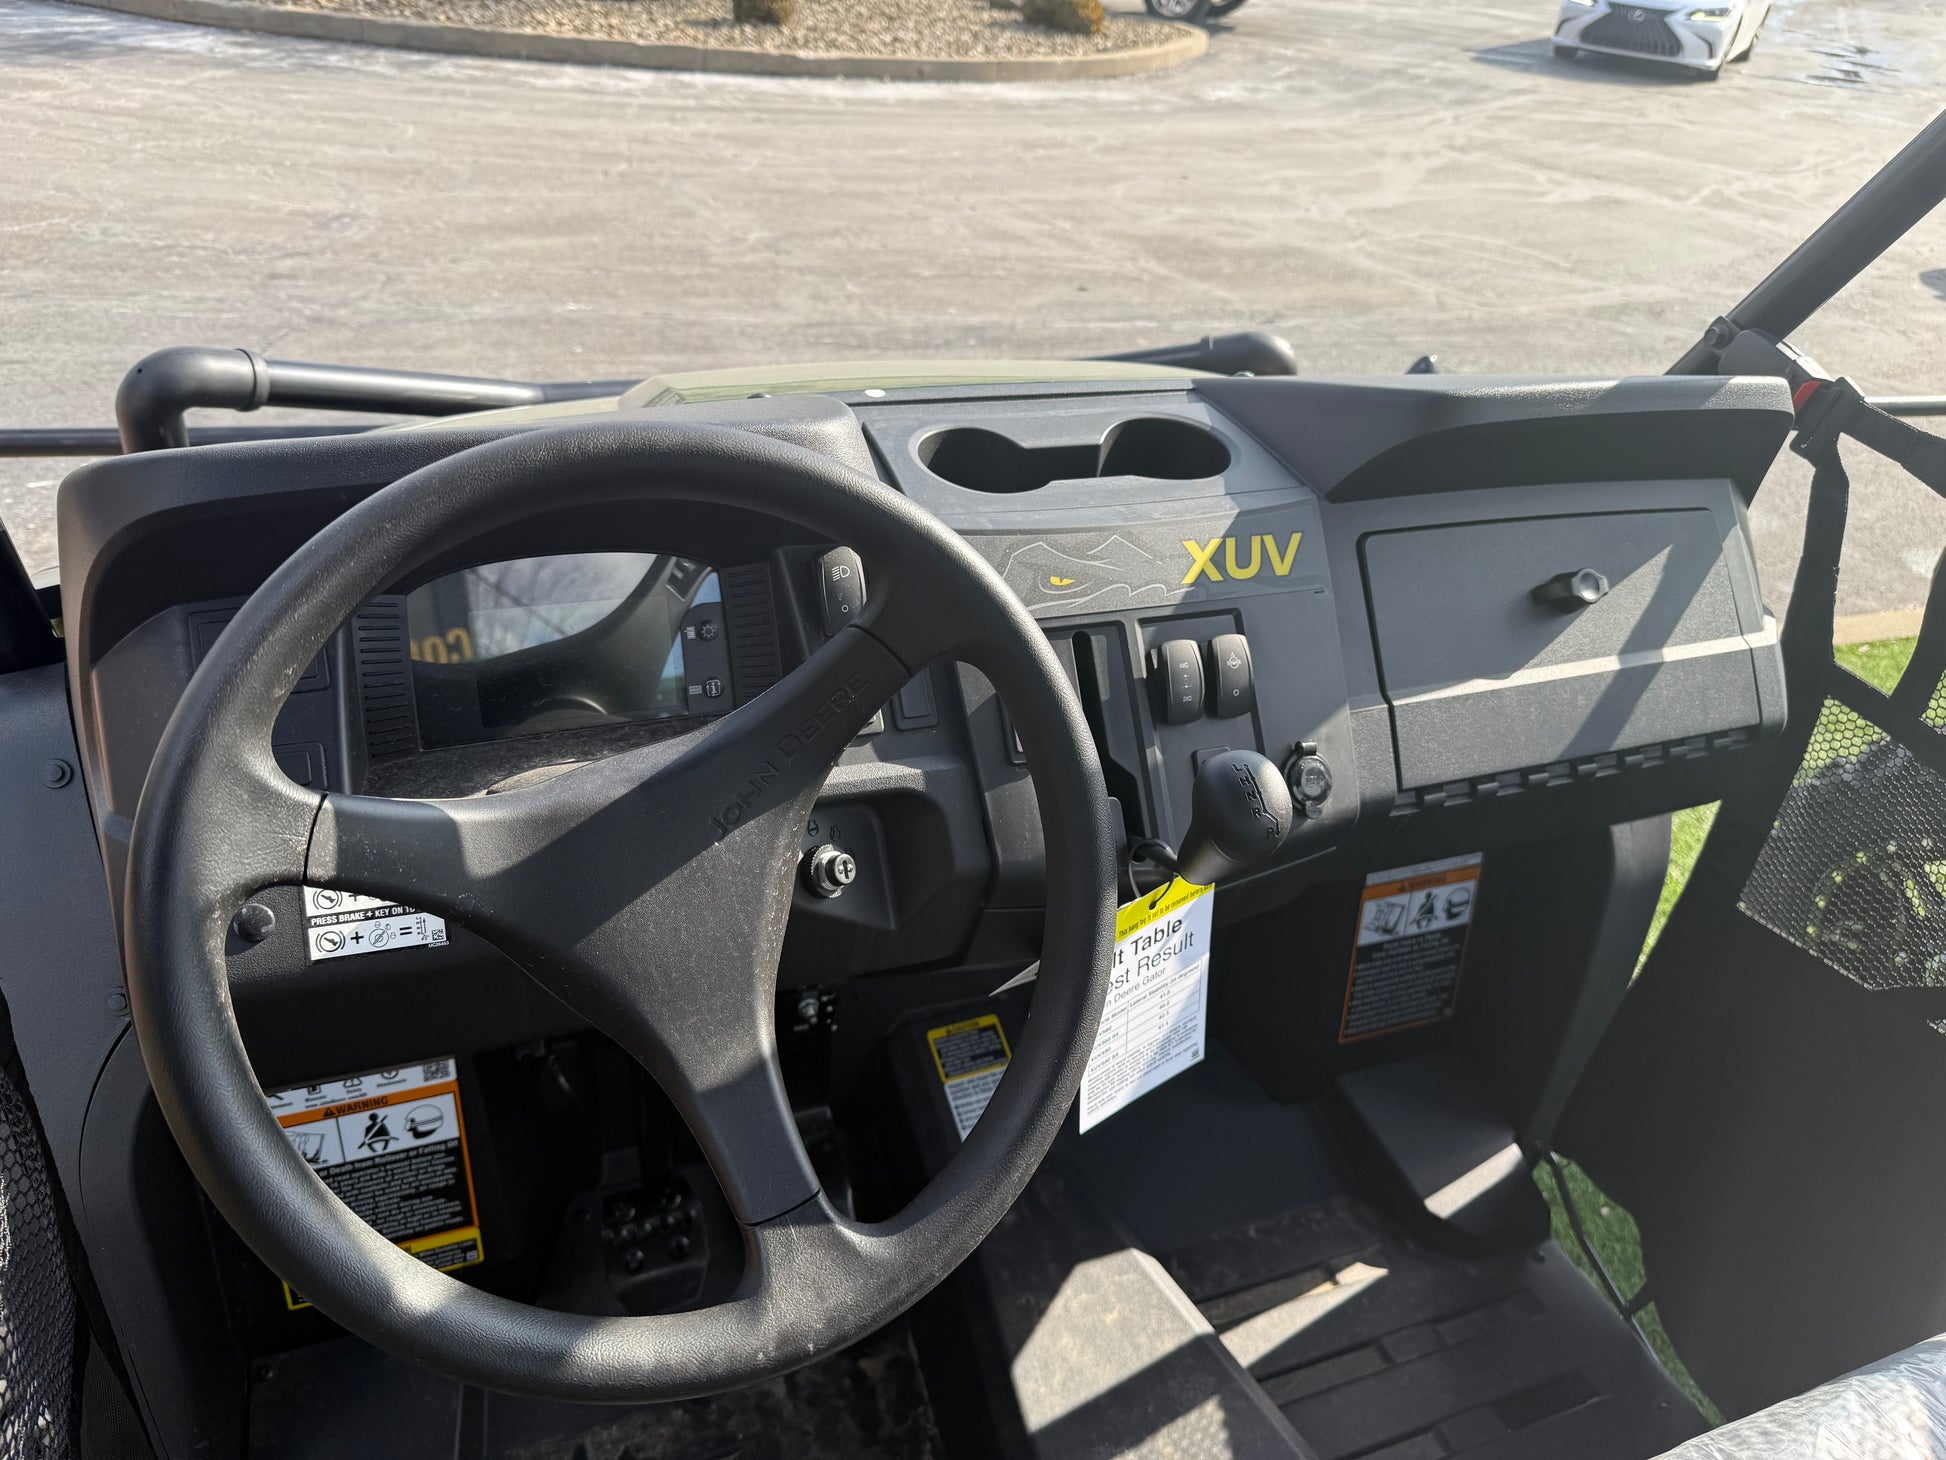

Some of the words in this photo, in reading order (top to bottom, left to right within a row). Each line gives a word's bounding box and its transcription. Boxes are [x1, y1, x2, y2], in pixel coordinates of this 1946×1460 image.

[1182, 533, 1302, 584] XUV
[709, 761, 781, 839] JOHN
[775, 673, 871, 763] DEERE
[1239, 777, 1252, 786] H
[1246, 792, 1257, 802] N
[1251, 807, 1262, 819] R
[1171, 892, 1188, 908] removed
[311, 917, 337, 926] PRESS
[339, 912, 365, 922] BRAKE
[375, 907, 389, 917] KEY
[392, 906, 403, 914] ON
[1113, 948, 1124, 968] lt
[1131, 919, 1182, 955] Table
[1108, 967, 1130, 994] est
[1138, 932, 1194, 976] Result
[1114, 982, 1140, 1002] Deere
[1142, 966, 1166, 985] Gator
[336, 1096, 389, 1114] WARNING
[329, 1163, 353, 1175] Death
[353, 1158, 373, 1169] from
[374, 1150, 407, 1164] Rollover
[418, 1142, 446, 1155] Falling
